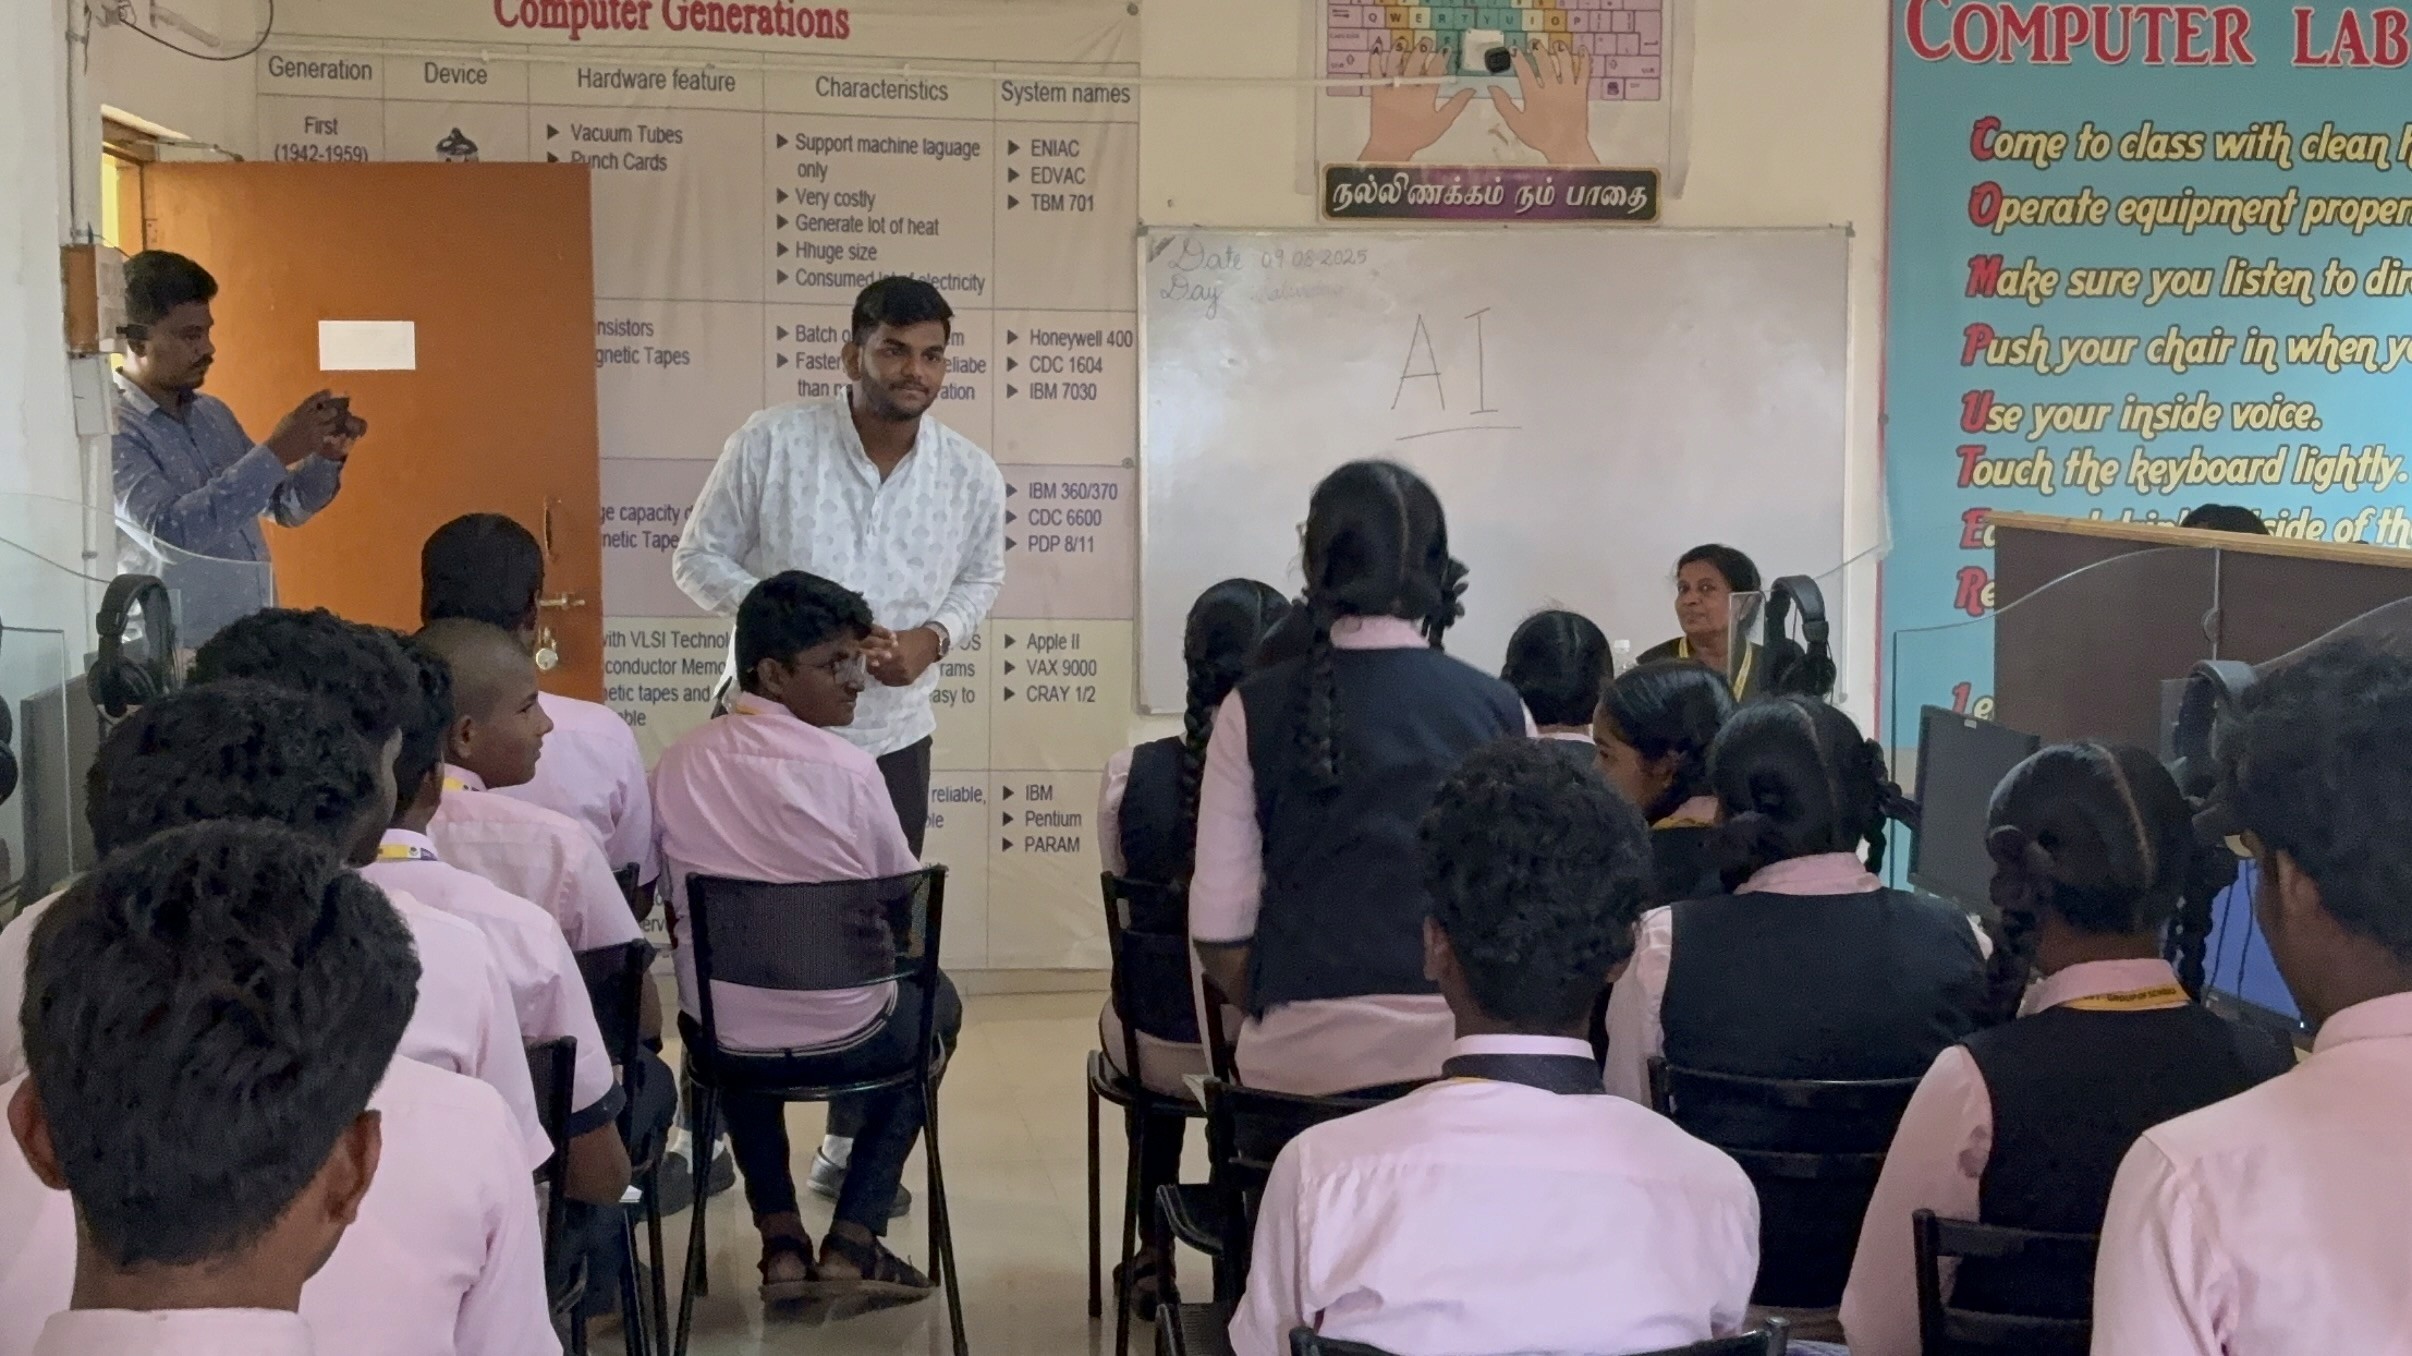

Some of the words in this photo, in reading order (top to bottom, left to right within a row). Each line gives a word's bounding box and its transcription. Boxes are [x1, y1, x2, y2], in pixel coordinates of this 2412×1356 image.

[494, 0, 652, 41] Computer
[661, 0, 851, 40] Generations
[1368, 12, 1378, 23] Q
[1389, 12, 1402, 23] W
[1415, 13, 1422, 23] E
[2291, 6, 2410, 69] LAB
[268, 55, 373, 81] Generation
[424, 62, 488, 86] Device
[578, 68, 667, 90] Hardware
[672, 71, 736, 92] feature
[815, 75, 949, 101] Characteristics
[1001, 81, 1067, 105] System
[1072, 86, 1131, 103] names
[304, 116, 339, 135] First
[571, 123, 632, 143] Vacuum
[637, 125, 684, 144] Tubes
[274, 143, 369, 163] (1942-1959)
[795, 132, 854, 156] Support
[857, 136, 919, 156] machine
[922, 138, 981, 161] laguage
[1031, 139, 1080, 158] ENIAC
[1970, 116, 2069, 170] Come
[2075, 120, 2112, 161] to
[2119, 120, 2207, 161] class
[2213, 120, 2293, 170] with
[2300, 121, 2392, 172] clean
[623, 152, 668, 172] Cards
[797, 161, 828, 183] only
[1031, 166, 1087, 186] EDVAC
[795, 188, 830, 210] Very
[834, 190, 877, 212] costly
[1031, 194, 1065, 212] TBM
[1069, 195, 1095, 213] 701
[1333, 172, 1504, 212] நல்லிணக்கம்
[1515, 176, 1556, 213] நம்
[1566, 184, 1649, 214] பாதை
[1968, 181, 2110, 235] Operate
[2116, 186, 2300, 235] equipment
[795, 213, 864, 235] Generate
[867, 215, 886, 234] lot
[889, 216, 905, 235] of
[907, 217, 940, 237] heat
[795, 241, 844, 265] Hhuge
[848, 243, 878, 262] size
[1168, 237, 1243, 271] Date
[1320, 249, 1368, 266] 2025
[795, 268, 875, 288] Consumed
[1965, 254, 2061, 307] Make
[2066, 267, 2144, 297] sure
[2142, 267, 2215, 307] you
[2220, 256, 2315, 307] listen
[2321, 257, 2358, 297] to
[1160, 273, 1221, 320] Day
[597, 318, 655, 337] nsistors
[795, 324, 838, 344] Batch
[1030, 328, 1103, 353] Honeywell
[1106, 330, 1134, 349] 400
[1961, 322, 2050, 375] Push
[2050, 336, 2141, 375] your
[2145, 324, 2238, 375] chair
[2241, 325, 2279, 375] in
[2286, 323, 2379, 374] when
[596, 345, 640, 368] gnetic
[643, 346, 690, 369] Tapes
[795, 352, 841, 370] Faster
[945, 357, 987, 374] eliabe
[1030, 355, 1065, 374] CDC
[1069, 355, 1104, 375] 1604
[1391, 307, 1499, 414] AI
[798, 379, 830, 397] than
[939, 384, 976, 400] ation
[1029, 382, 1057, 401] IBM
[1061, 383, 1098, 401] 7030
[1960, 389, 2025, 433] Use
[2025, 401, 2114, 442] your
[2118, 389, 2223, 442] inside
[2231, 391, 2323, 432] voice.
[1956, 445, 2057, 495] Touch
[2063, 446, 2120, 495] the
[2126, 446, 2290, 495] keyboard
[2292, 443, 2409, 493] lightly.
[1029, 482, 1057, 501] IBM
[1061, 483, 1118, 502] 360/370
[619, 504, 681, 526] capacity
[1029, 509, 1062, 527] CDC
[1066, 509, 1103, 527] 6600
[2333, 505, 2378, 544] of
[2376, 505, 2412, 549] th
[602, 531, 638, 549] netic
[642, 531, 681, 552] Tape
[1029, 535, 1061, 553] PDP
[1065, 535, 1095, 554] 8/11
[603, 631, 626, 648] ith
[630, 631, 666, 649] VLSI
[671, 631, 730, 649] Technol
[1026, 633, 1069, 655] Apple
[1071, 633, 1081, 651] II
[605, 658, 677, 676] conductor
[682, 658, 726, 676] Memo
[940, 663, 976, 677] rams
[1026, 659, 1058, 676] VAX
[1062, 659, 1098, 677] 9000
[639, 685, 679, 705] tapes
[683, 685, 711, 702] and
[929, 689, 958, 708] asy
[961, 687, 976, 704] to
[1026, 685, 1070, 703] CRAY
[1074, 685, 1096, 704] 1/2
[931, 786, 986, 805] reliable,
[1025, 784, 1053, 802] IBM
[1025, 810, 1083, 828] Pentium
[1024, 836, 1081, 853] PARAM
